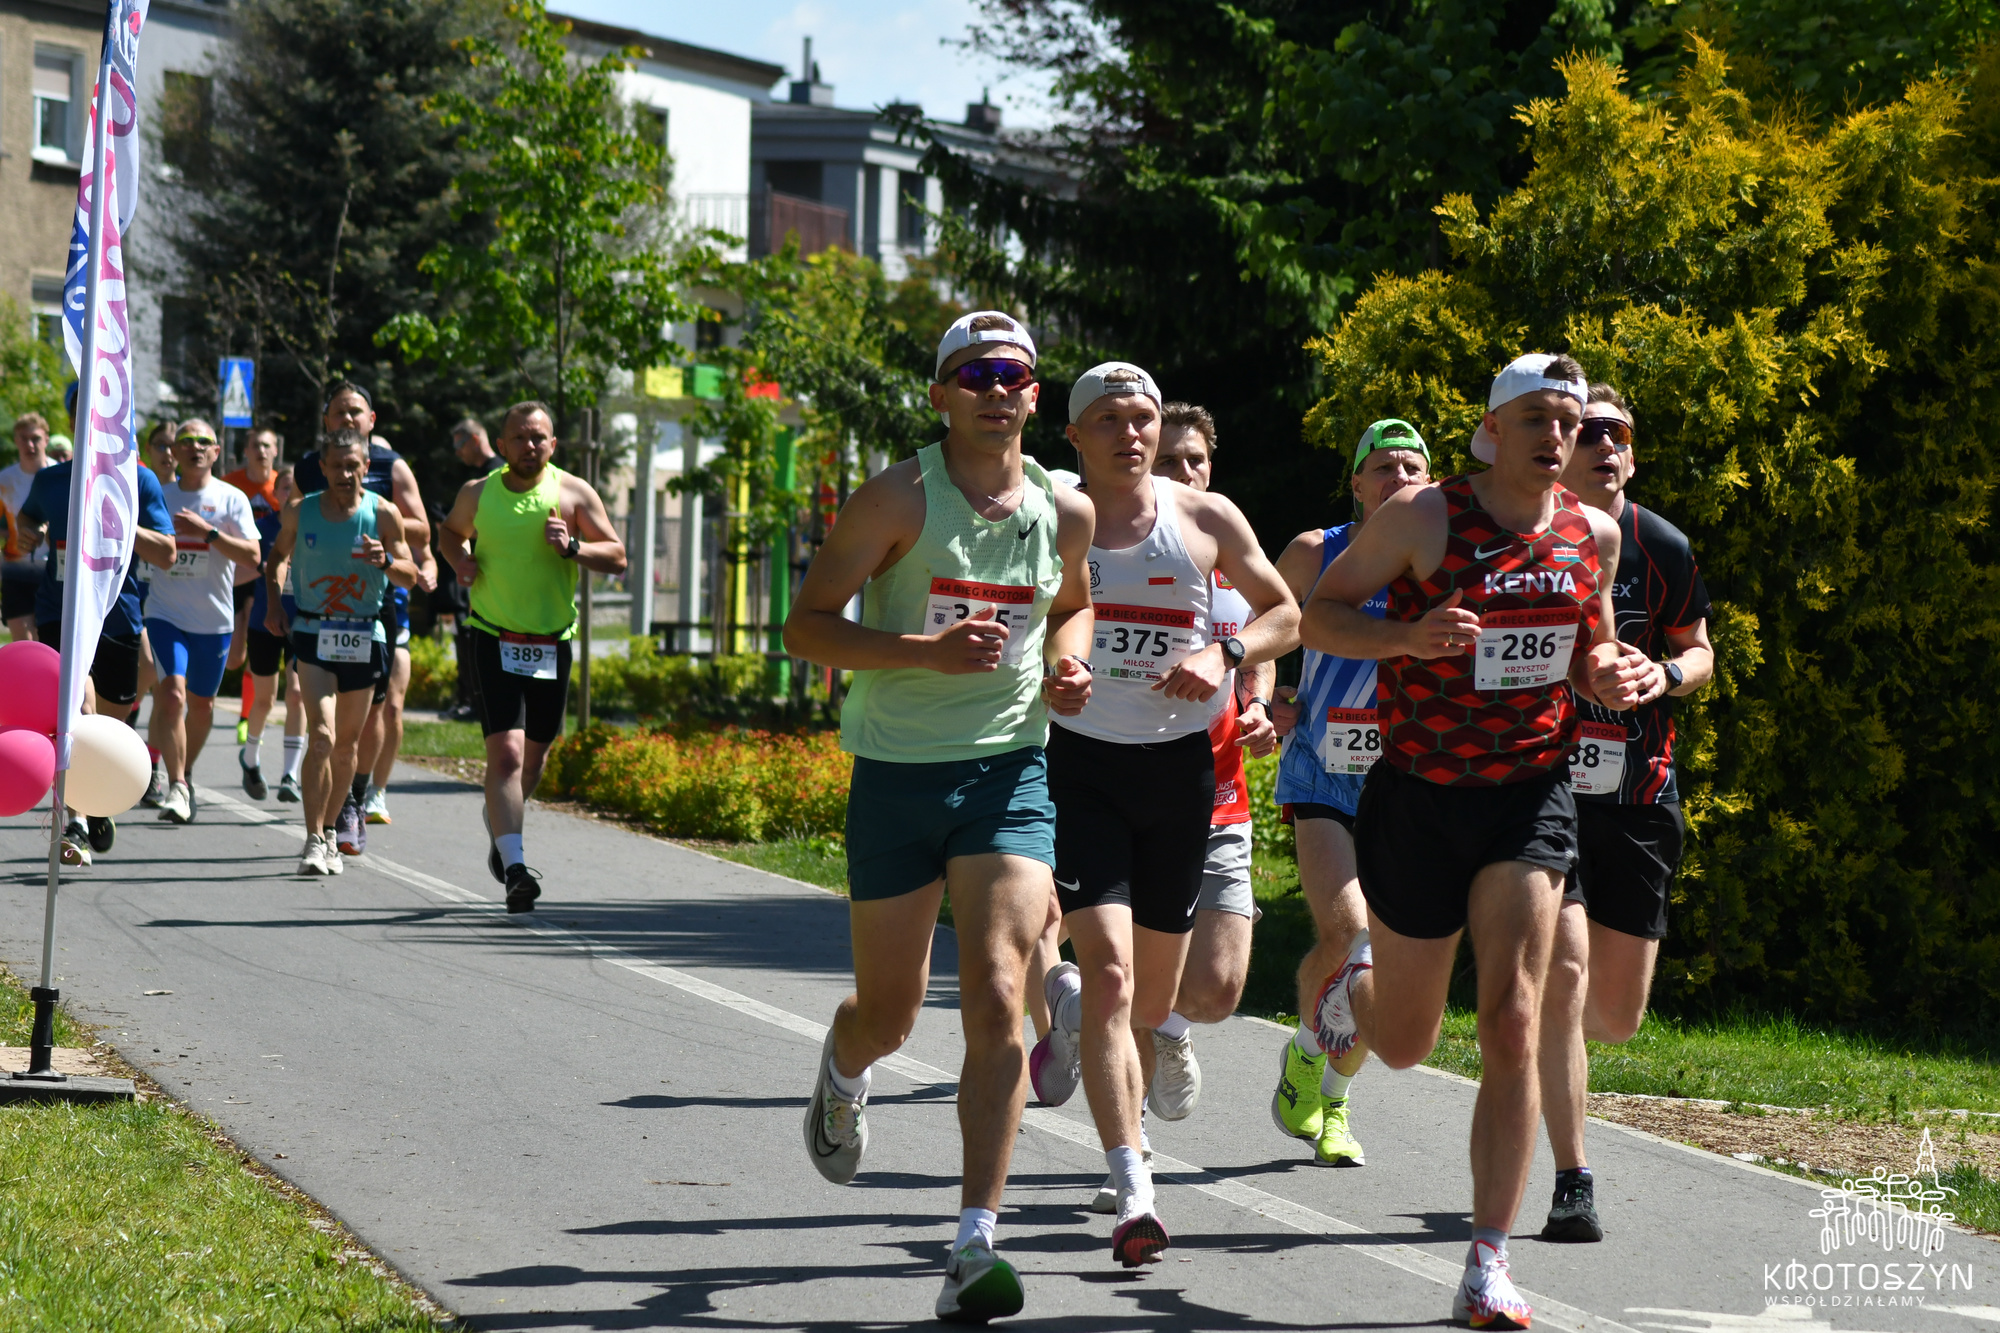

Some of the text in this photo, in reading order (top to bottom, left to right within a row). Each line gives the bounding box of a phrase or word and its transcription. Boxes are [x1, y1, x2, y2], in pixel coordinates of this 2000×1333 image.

[175, 552, 198, 566] 97
[1485, 571, 1577, 594] KENYA
[937, 583, 1030, 600] 44 BIEG KROTOSA
[951, 603, 1010, 629] 35
[1097, 608, 1190, 625] 44 BIEG KROTOSA
[1485, 612, 1576, 625] 44 BIEG KROTOSA
[332, 633, 360, 648] 106
[1111, 627, 1169, 657] 375
[1501, 632, 1556, 661] 286
[511, 646, 543, 662] 389
[1122, 658, 1155, 669] MIŁOSZ
[1504, 663, 1551, 674] KRZYSZTOF
[1345, 713, 1367, 721] BIEG
